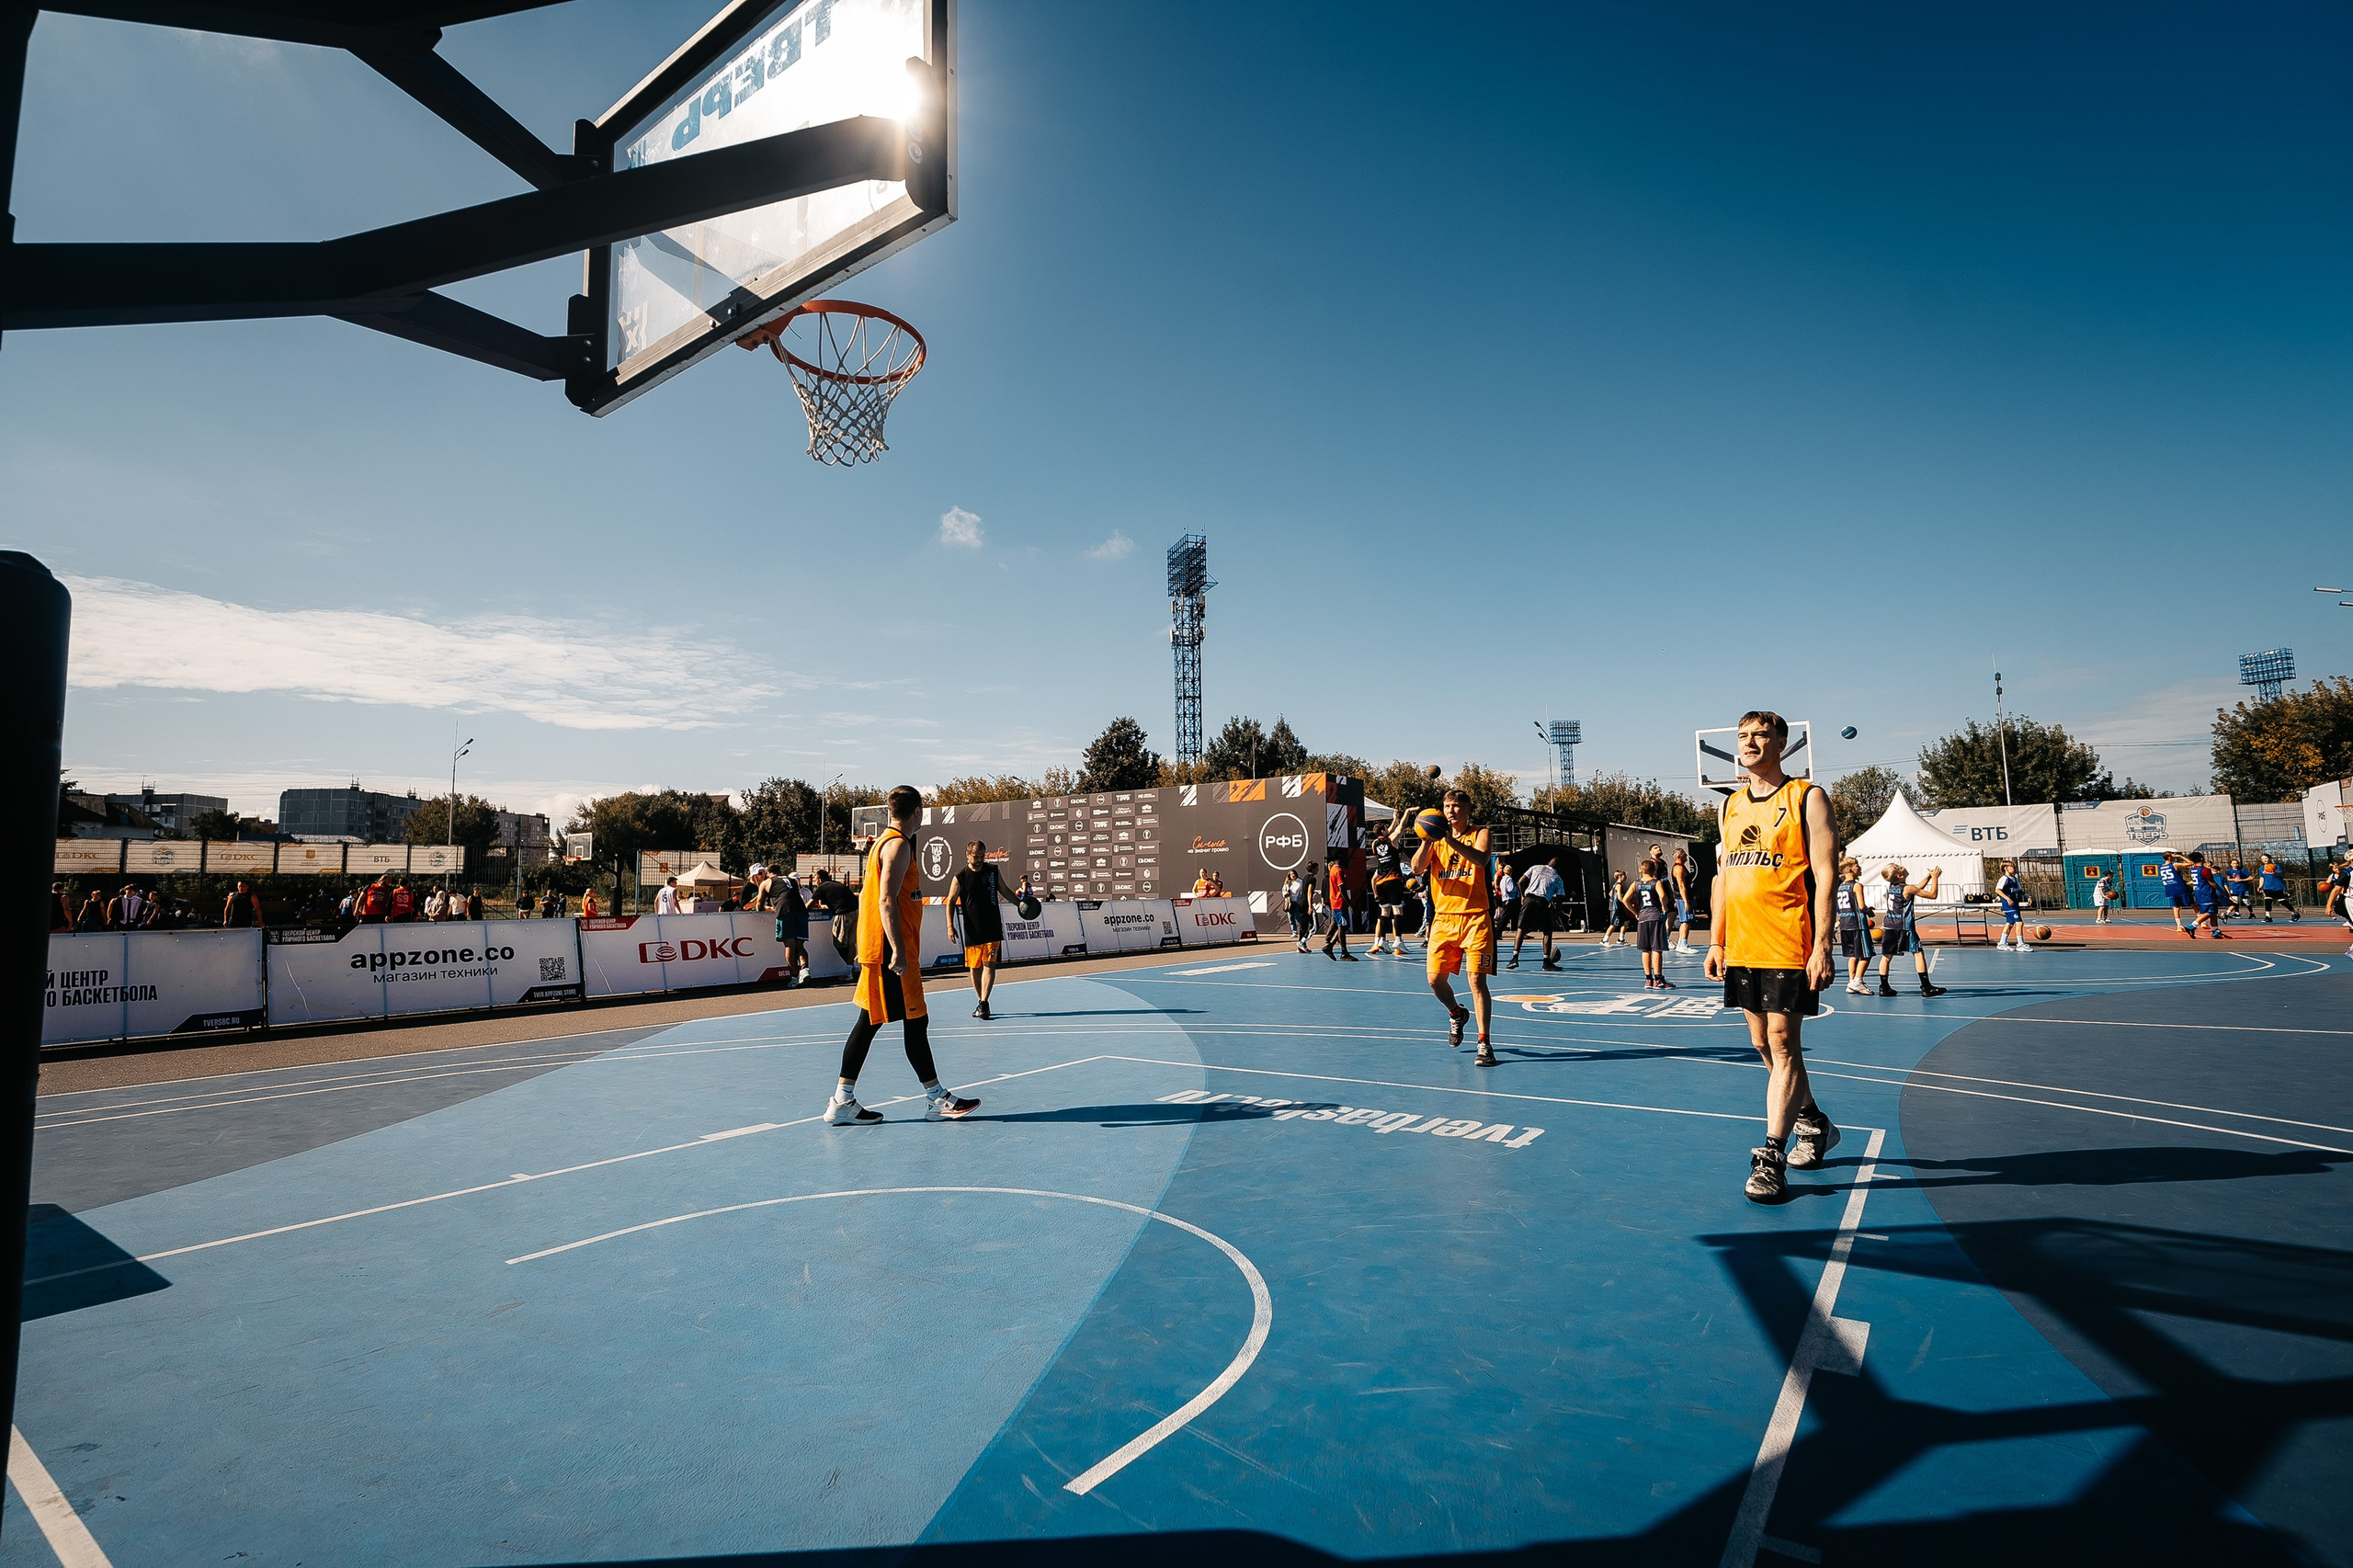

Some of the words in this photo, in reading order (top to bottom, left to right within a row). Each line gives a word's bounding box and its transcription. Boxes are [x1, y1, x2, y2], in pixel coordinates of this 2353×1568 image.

[1773, 807, 1788, 828] 7
[1971, 826, 2009, 842] ВТБ
[2126, 830, 2169, 842] ТВЕРЬ
[1265, 834, 1303, 849] РФБ
[233, 853, 260, 861] DKC
[373, 855, 391, 863] ВТБ
[2160, 869, 2175, 881] 55
[396, 894, 409, 903] 69
[1641, 890, 1653, 907] 2
[1836, 891, 1851, 910] 22
[1103, 913, 1154, 926] appzone.co
[1209, 912, 1237, 926] DKC
[1005, 921, 1027, 932] ТВЕРСКОЙ
[1027, 921, 1040, 930] ЦЕНТР
[307, 934, 336, 942] БАСКЕТБОЛА
[1007, 931, 1029, 940] УЛИЧНОГО
[1029, 928, 1055, 939] БАСКЕТБОЛА
[680, 937, 755, 961] DKC
[350, 946, 515, 971] appzone.co
[1480, 953, 1492, 968] 13
[60, 970, 108, 990] ЦЕНТР
[373, 971, 438, 983] магазин
[440, 966, 498, 980] техники
[62, 984, 158, 1006] БАСКЕТБОЛА
[203, 1017, 240, 1028] TVERSBC.RU
